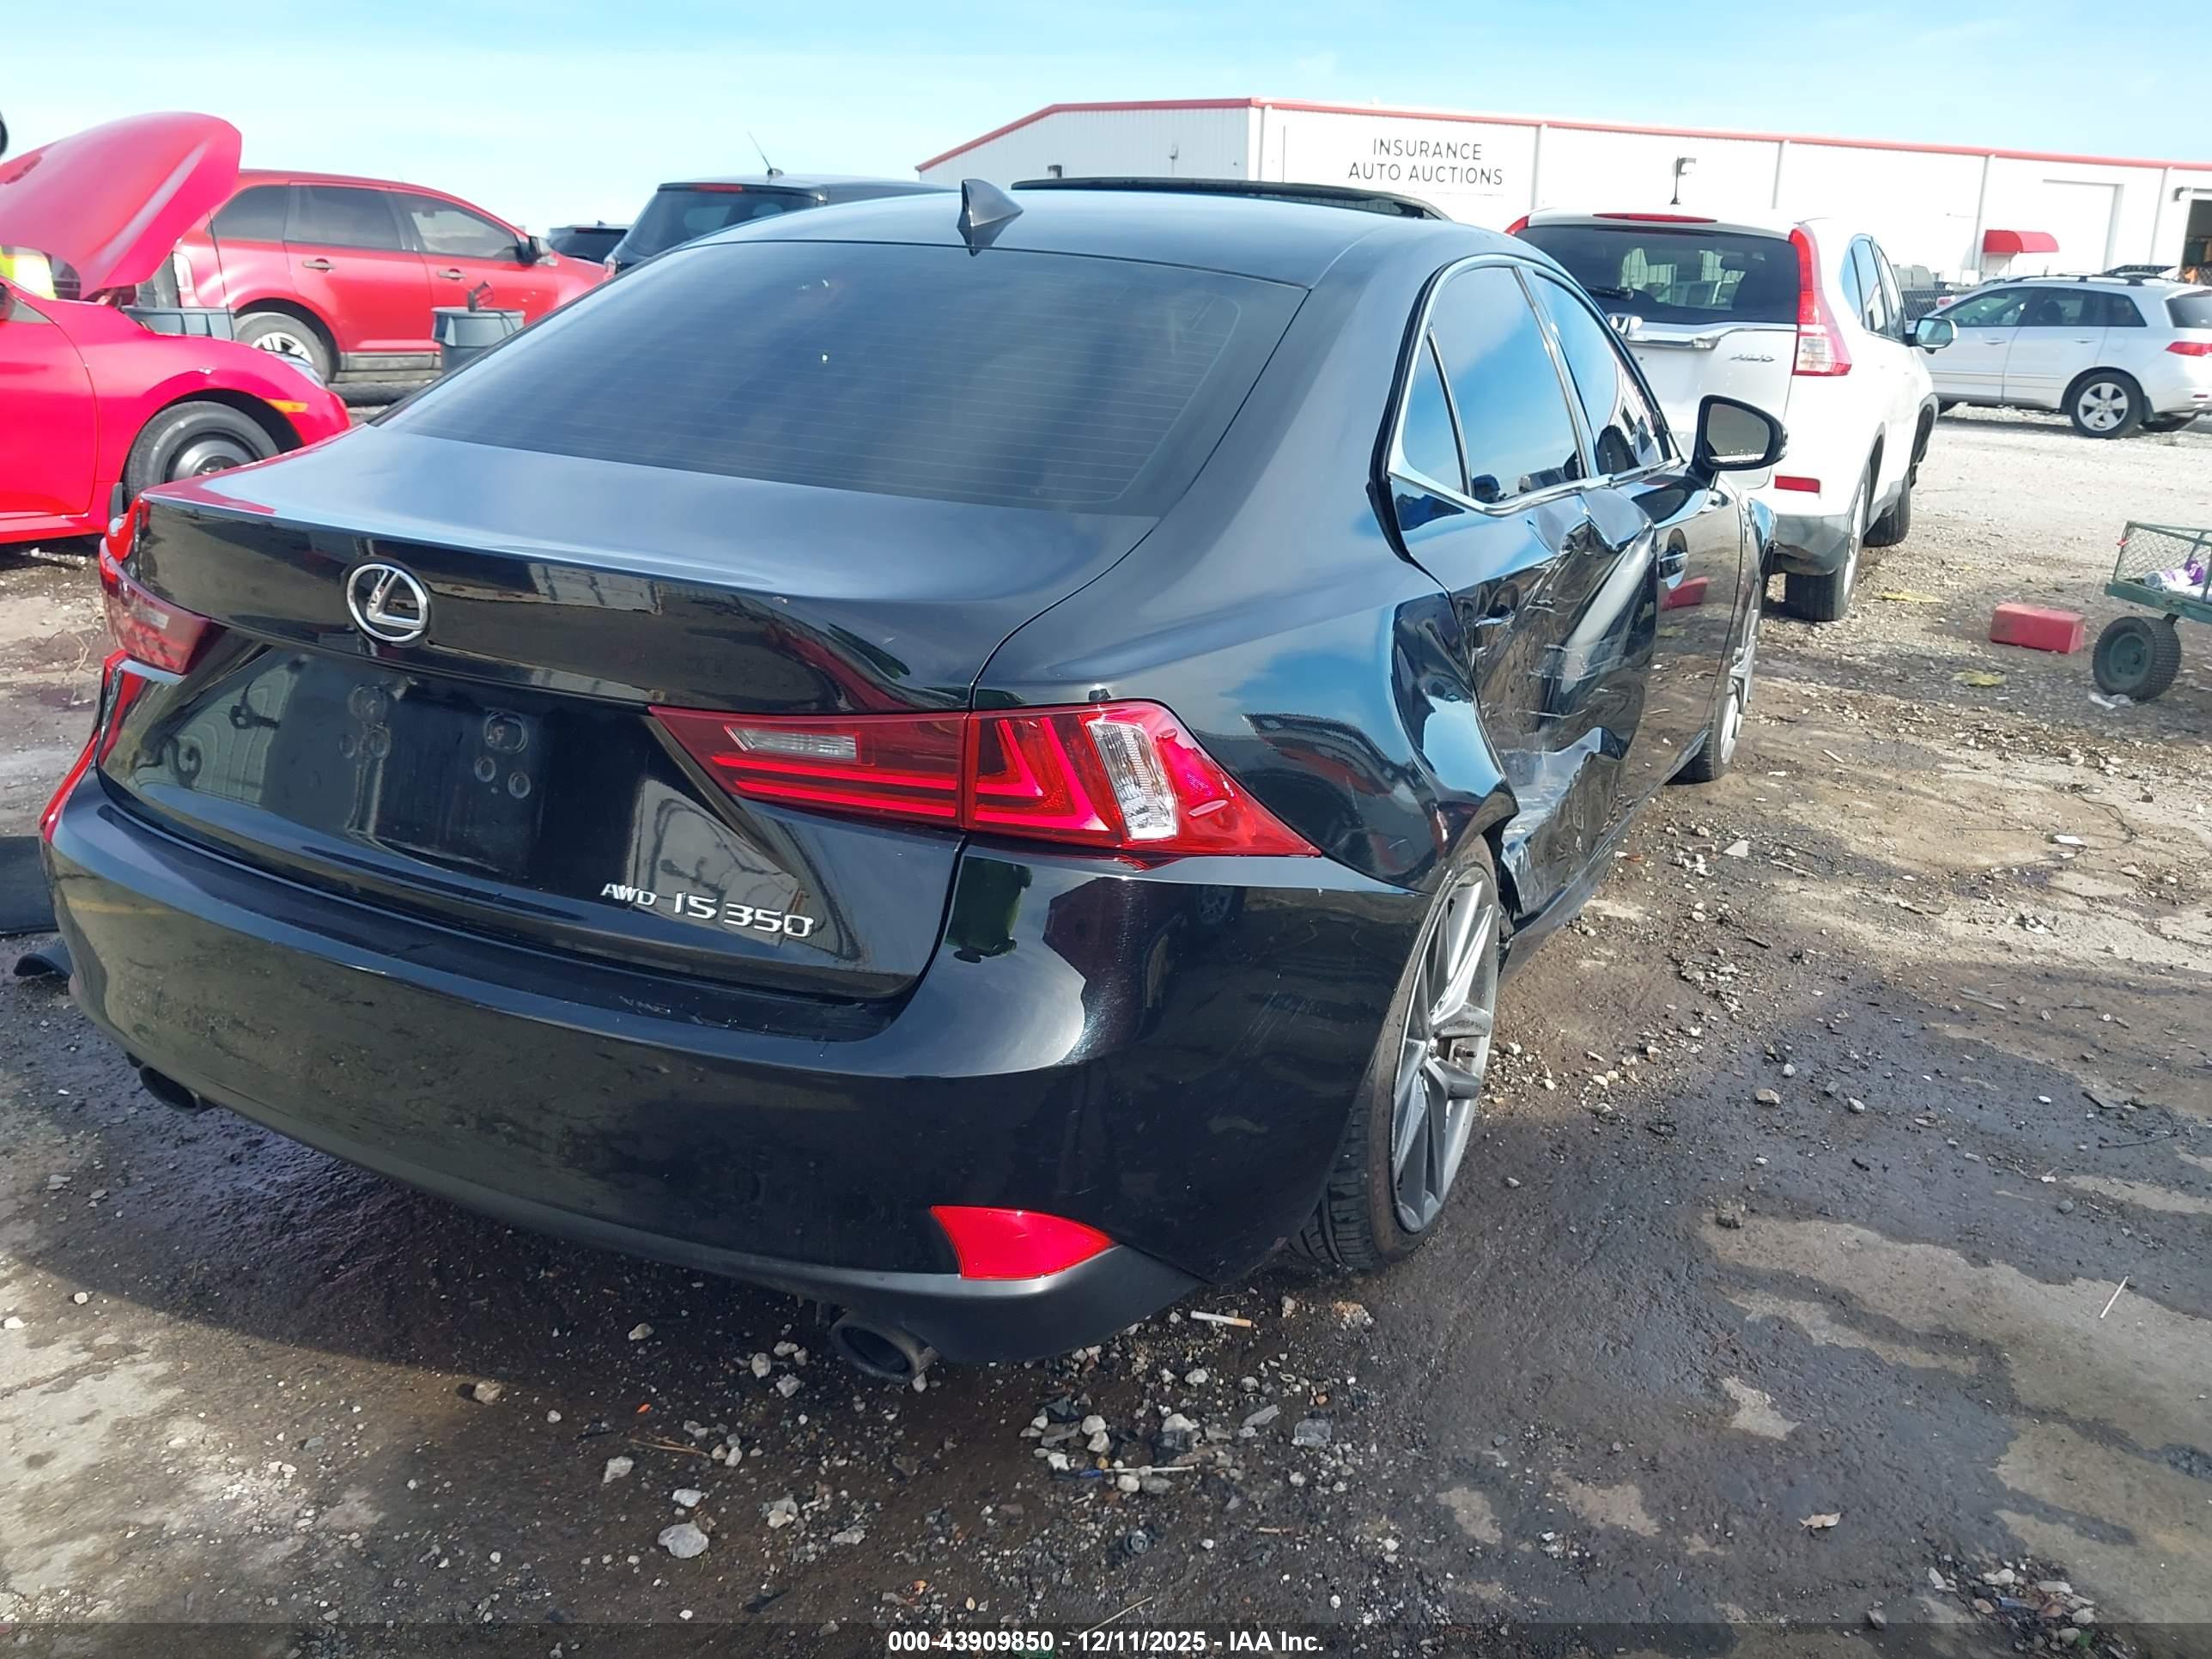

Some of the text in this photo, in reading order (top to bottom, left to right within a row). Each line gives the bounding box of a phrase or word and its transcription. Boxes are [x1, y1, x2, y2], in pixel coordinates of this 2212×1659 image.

[1373, 137, 1482, 161] INSURANCE
[1348, 161, 1504, 185] AUTO AUCTIONS
[600, 882, 658, 907] AWD
